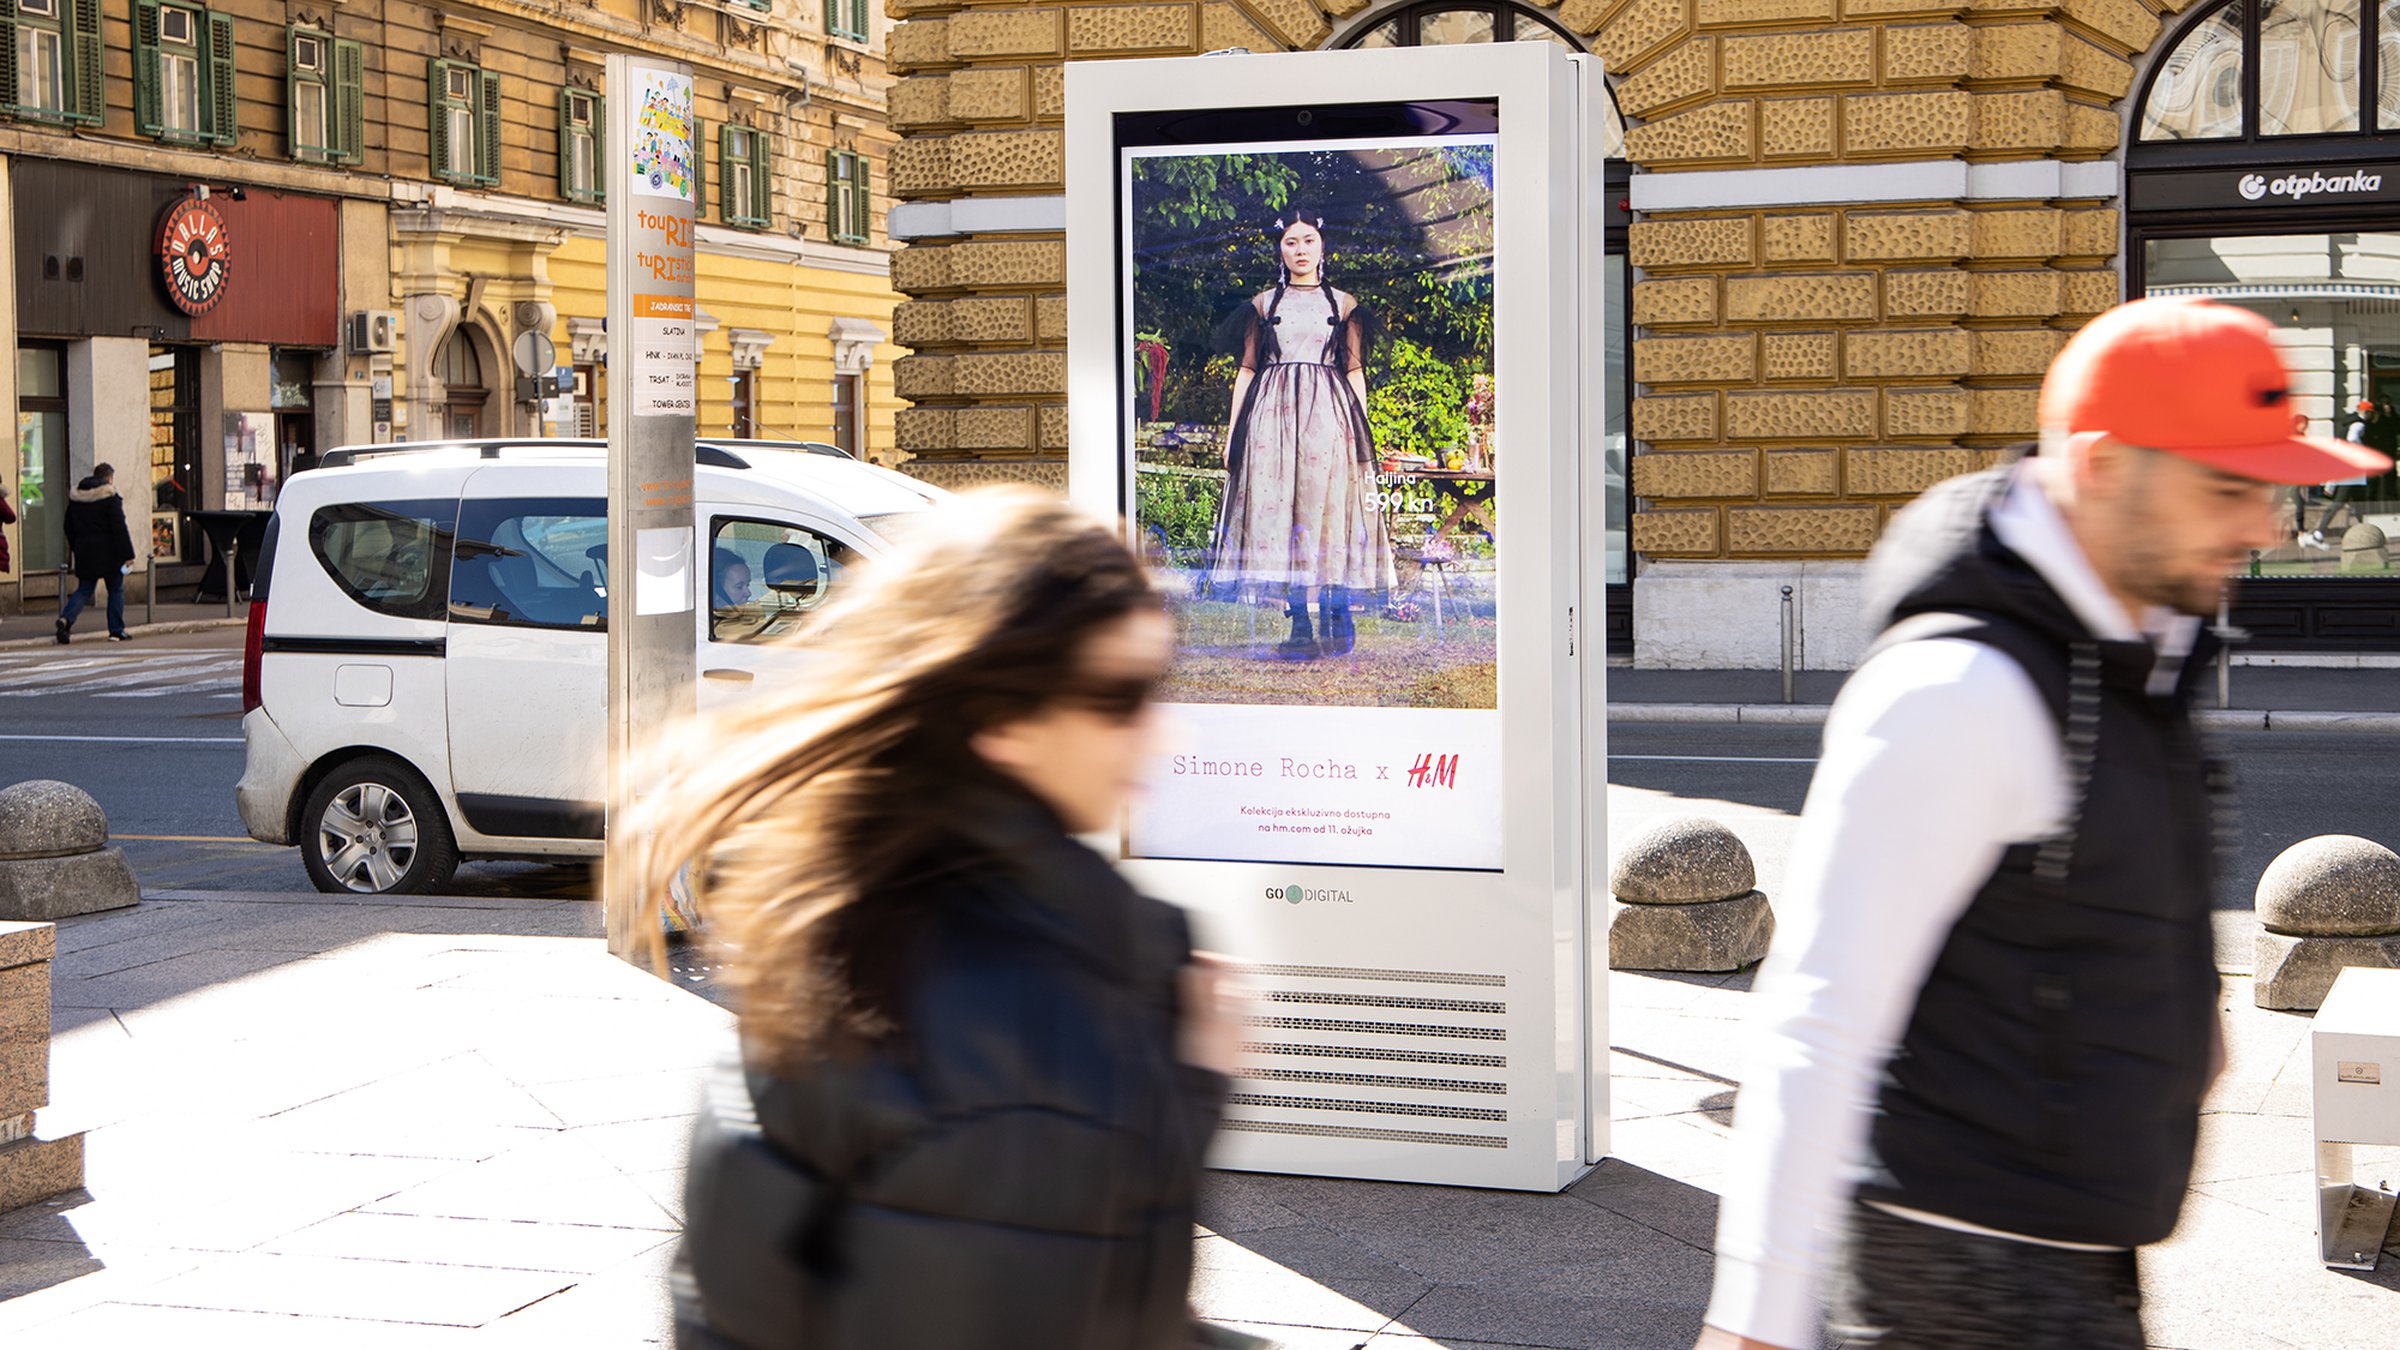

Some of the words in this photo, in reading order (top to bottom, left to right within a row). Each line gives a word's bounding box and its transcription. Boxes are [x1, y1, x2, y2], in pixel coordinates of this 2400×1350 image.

[2270, 169, 2382, 200] otpbanka
[171, 214, 224, 257] DALLAS
[172, 256, 200, 301] MUSIC
[200, 261, 223, 300] SHOP
[645, 351, 660, 359] HNK
[649, 375, 669, 384] TRSAT
[652, 400, 673, 408] TOWER
[1364, 471, 1416, 487] Haljina
[1364, 492, 1403, 512] 599
[1408, 492, 1433, 513] kn
[1173, 754, 1263, 777] Simone
[1280, 757, 1357, 779] Rocha
[1375, 766, 1389, 780] x
[1407, 753, 1459, 790] H&M
[1240, 805, 1284, 818] Kolekcija
[1285, 807, 1342, 818] ekskluzivno
[1344, 809, 1391, 820] dostupna
[1273, 823, 1311, 833] hm.com
[1313, 825, 1325, 834] od
[1341, 825, 1373, 837] ožujka
